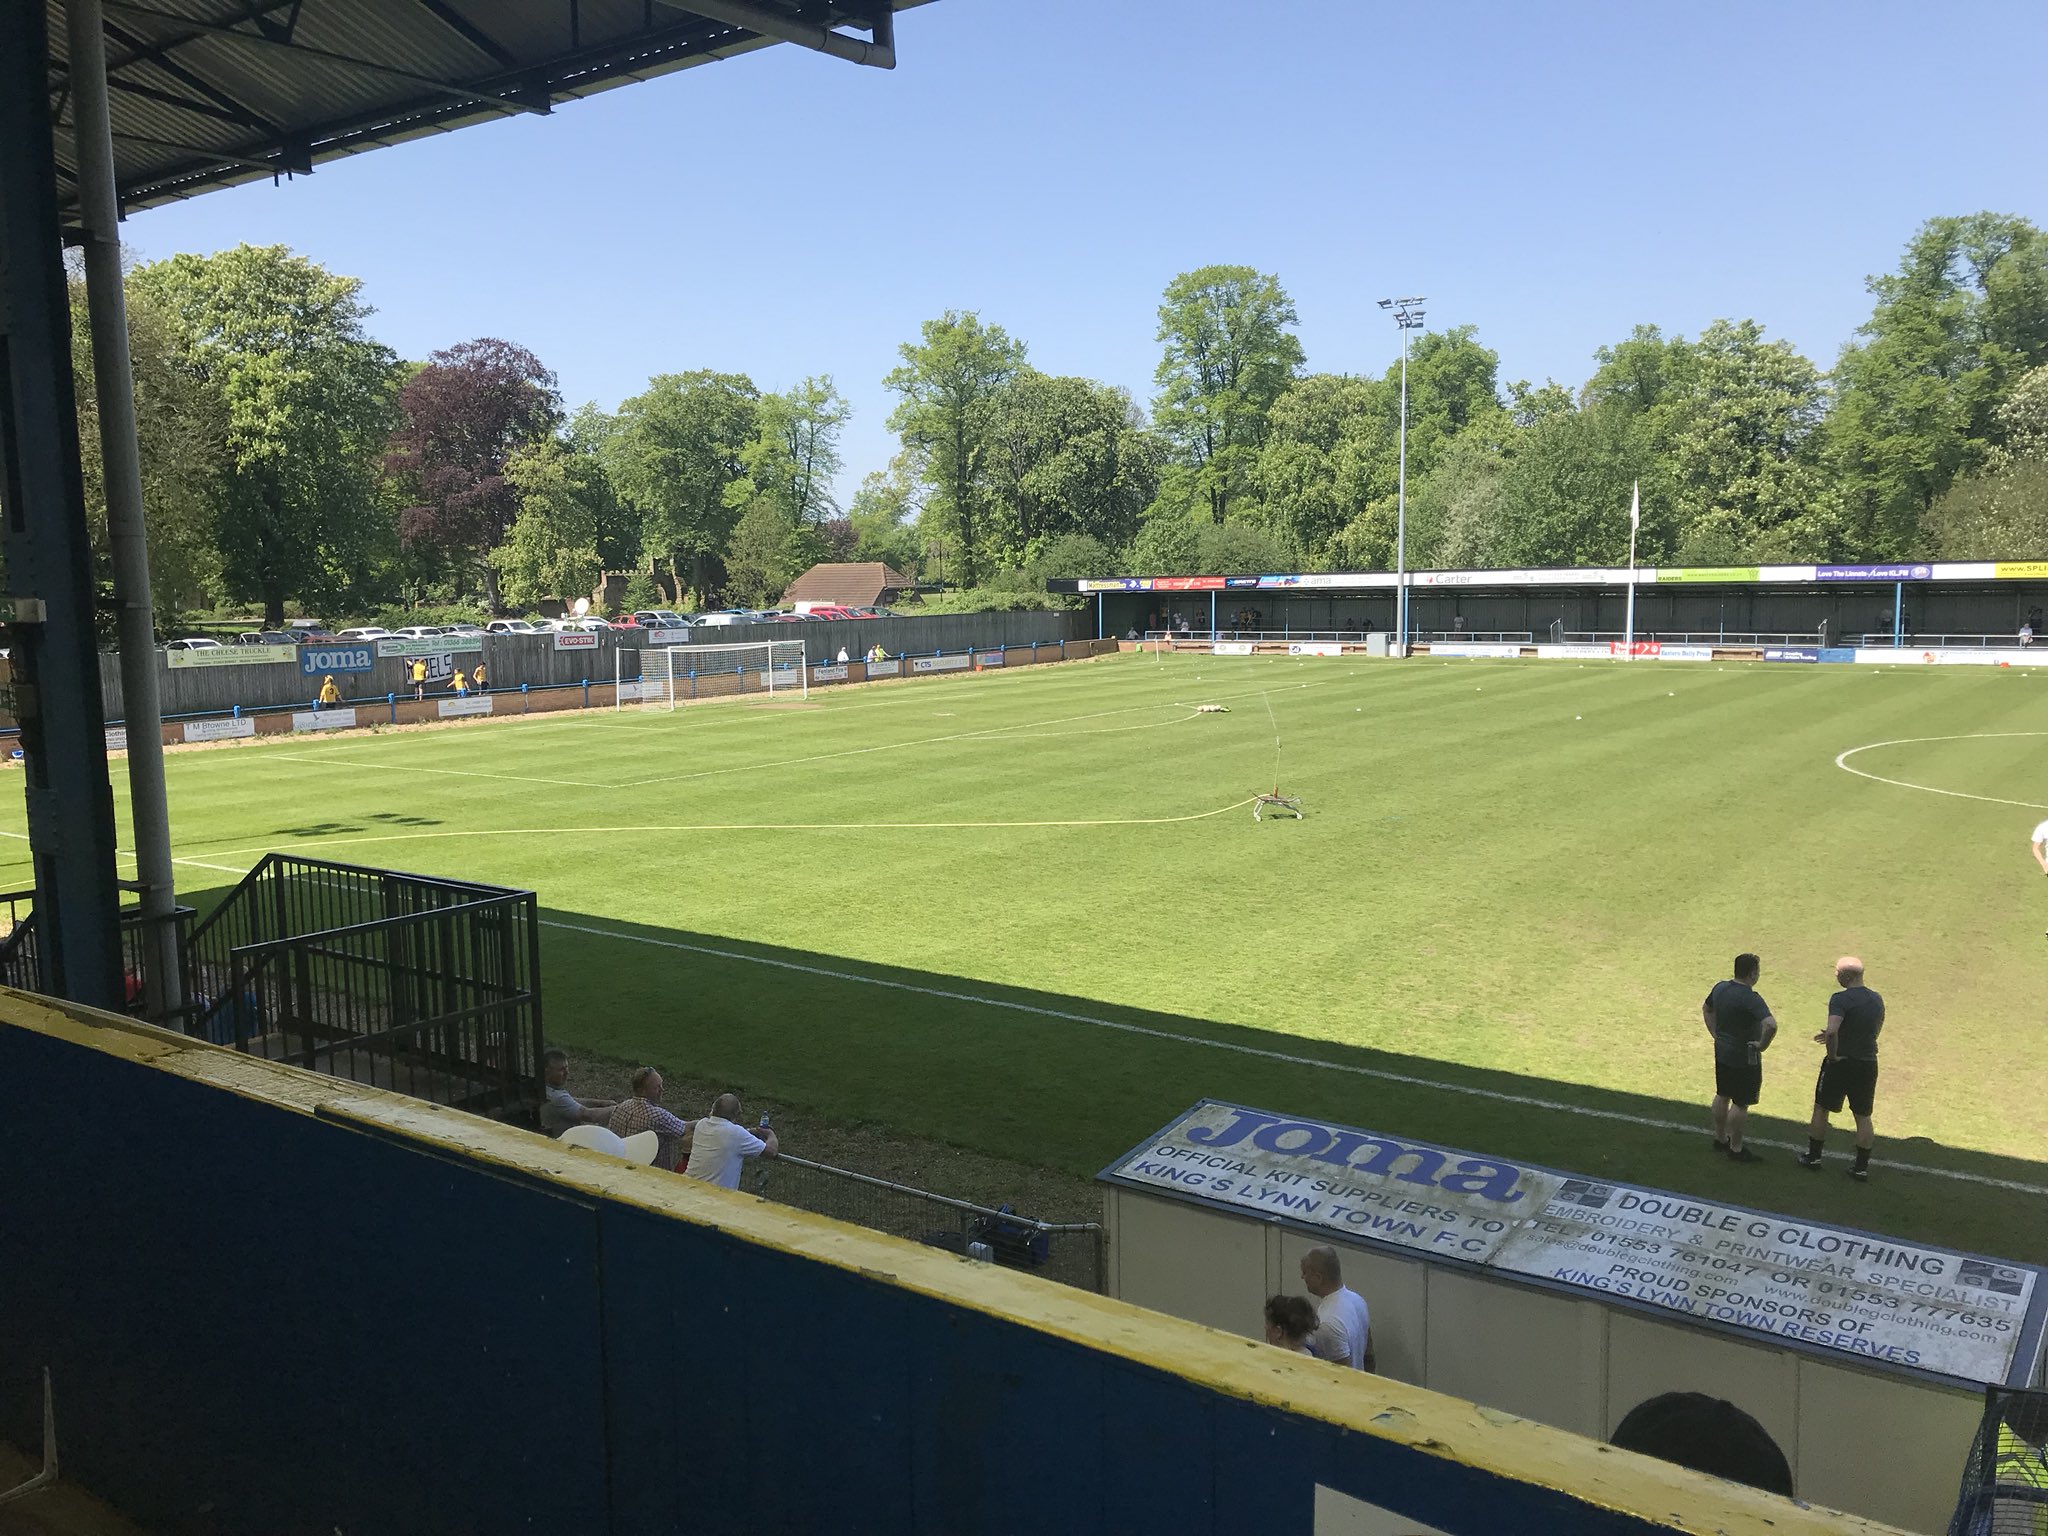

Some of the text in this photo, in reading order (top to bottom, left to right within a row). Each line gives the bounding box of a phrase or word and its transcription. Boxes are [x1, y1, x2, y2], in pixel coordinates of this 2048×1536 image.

[1310, 577, 1332, 586] ama
[1435, 574, 1472, 584] Carter
[211, 649, 239, 657] CHEESE
[240, 647, 271, 656] TRUCKLE
[920, 661, 932, 669] CTS
[202, 722, 230, 730] Browne
[231, 718, 247, 727] LTD
[1133, 1159, 1237, 1193] KING'S
[1237, 1183, 1322, 1214] LYNN
[1329, 1204, 1428, 1240] TOWN
[1155, 1144, 1506, 1233] OFFICIAL KIT SUPPLIERS TO
[1542, 1203, 2019, 1313] EMBROIDERY & PRINTWEAR SPECIALIST
[1618, 1195, 1946, 1276] DOUBLE G CLOTHING
[1526, 1232, 1999, 1345] sales@doublegclothing.com www.doublegclothing.com
[1553, 1266, 1922, 1365] KING'S LYNN TOWN RESERVES
[1590, 1231, 1663, 1255] 01553
[1668, 1248, 1760, 1277] 761047
[1771, 1271, 1811, 1290] OR
[1818, 1281, 1900, 1309] 01553
[1909, 1300, 2012, 1333] 777635
[1607, 1263, 1876, 1336] PROUD SPONSORS OF
